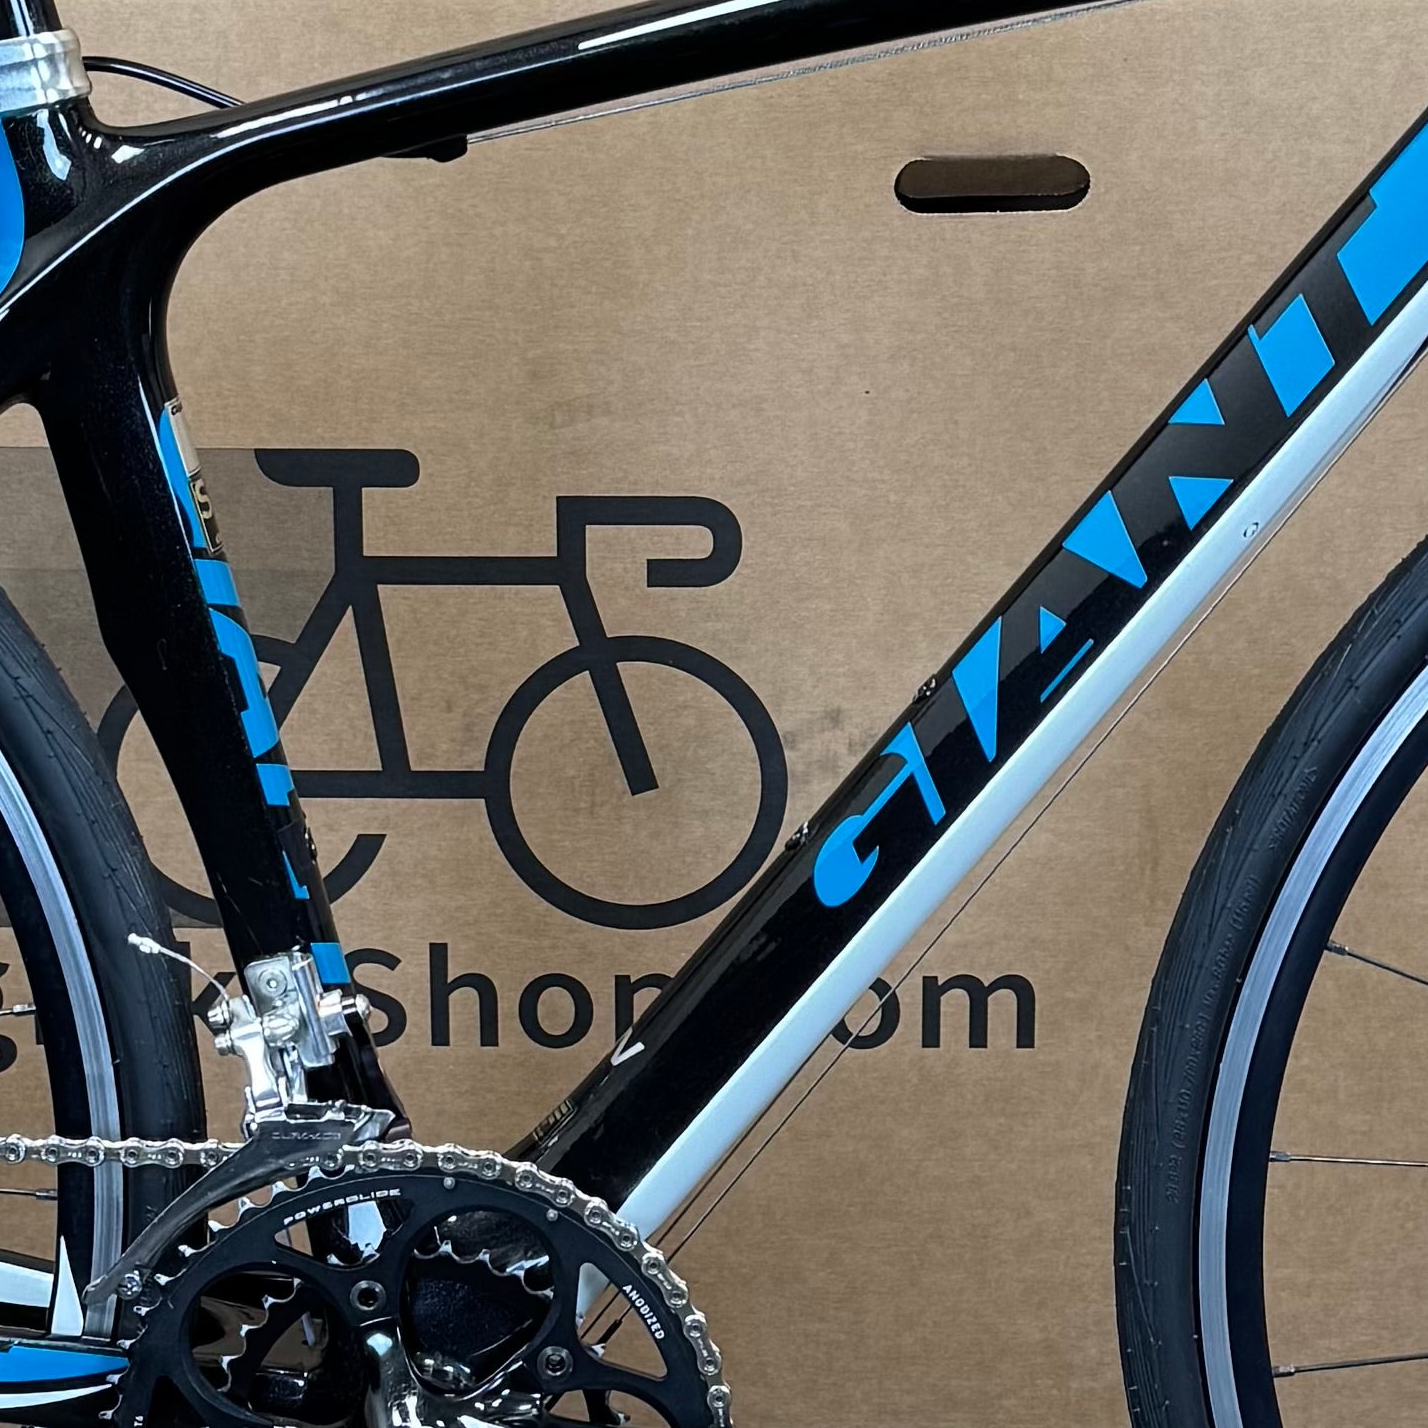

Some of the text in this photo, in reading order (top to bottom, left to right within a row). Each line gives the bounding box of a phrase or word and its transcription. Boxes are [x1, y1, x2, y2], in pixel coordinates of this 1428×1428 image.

[787, 192, 1371, 930] GIANT
[283, 1188, 401, 1225] POWERGLIDE
[622, 1284, 665, 1340] ANODIZED
